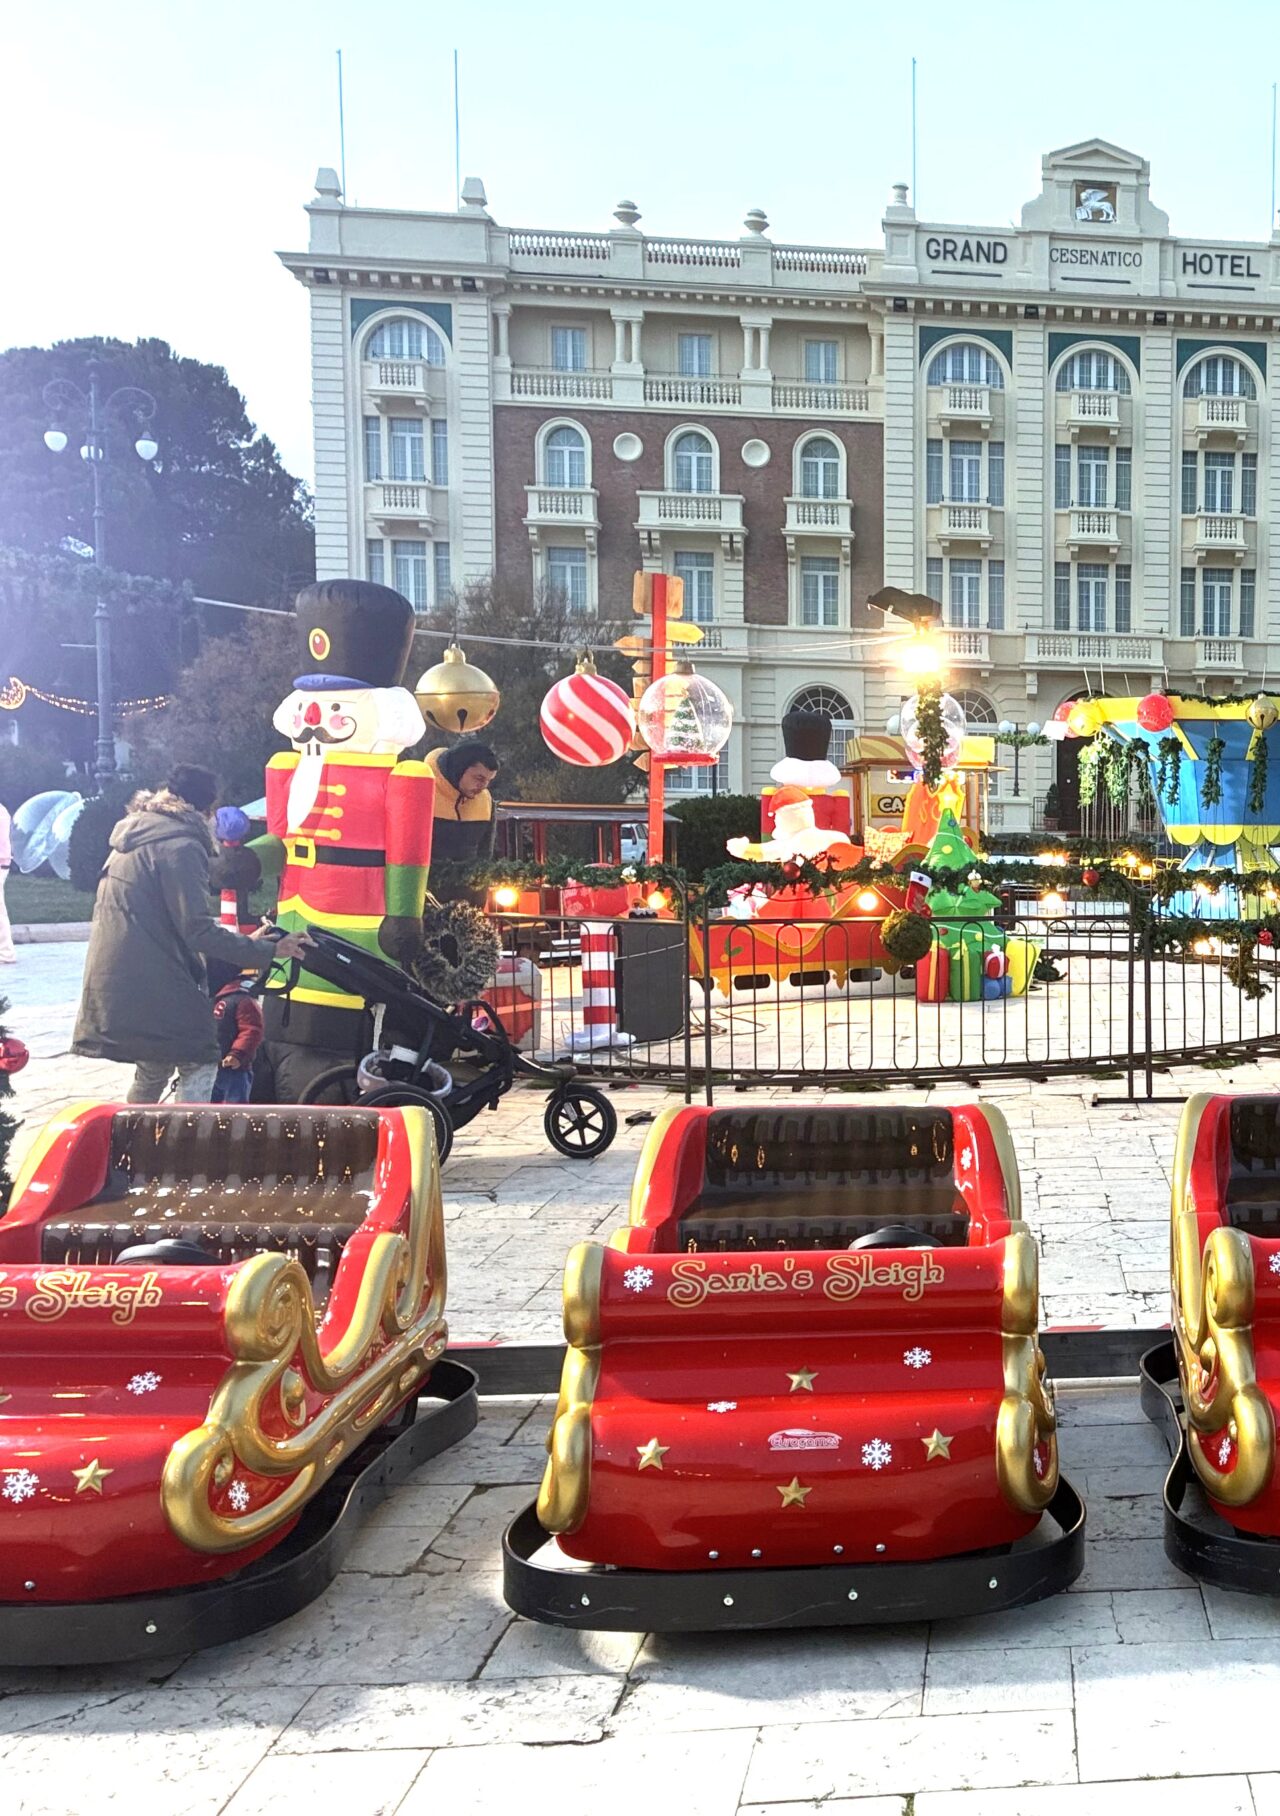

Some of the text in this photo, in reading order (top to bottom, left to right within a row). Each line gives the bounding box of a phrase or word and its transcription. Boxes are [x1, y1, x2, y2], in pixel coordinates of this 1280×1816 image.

[926, 237, 1261, 278] GRAND CESENATICO HOTEL
[878, 796, 906, 813] CA
[25, 1271, 163, 1326] Sleigh
[667, 1252, 945, 1308] Santa's Sleigh
